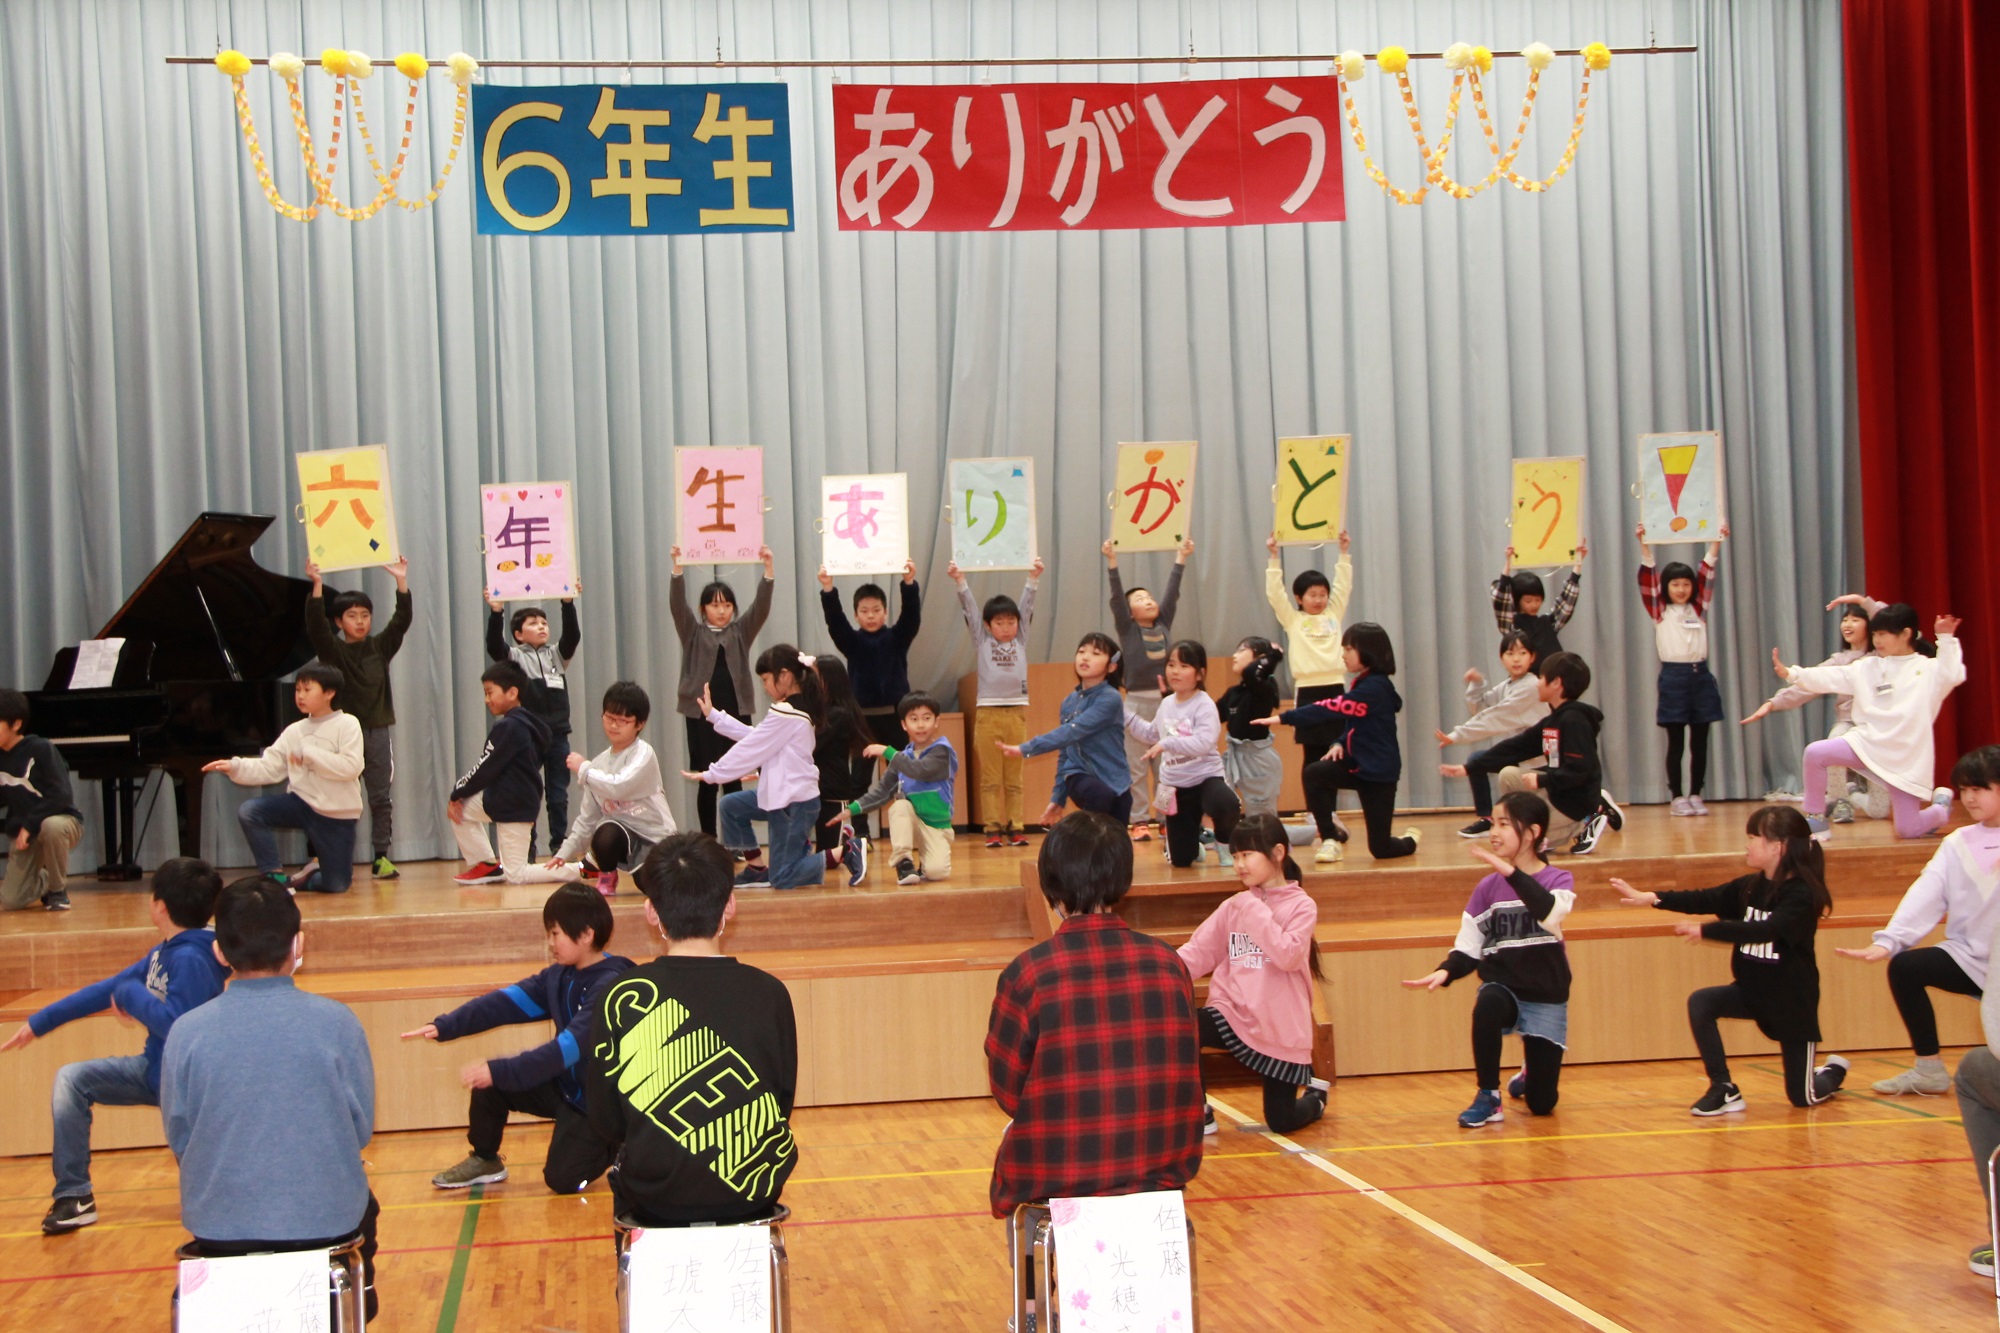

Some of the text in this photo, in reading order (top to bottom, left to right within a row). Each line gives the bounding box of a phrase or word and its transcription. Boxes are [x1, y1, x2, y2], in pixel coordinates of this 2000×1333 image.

[482, 87, 789, 231] 6年生
[839, 84, 1326, 229] ありがとう
[306, 464, 381, 530] 六
[686, 467, 746, 532] 生
[829, 483, 884, 549] あ
[964, 489, 1007, 546] り
[1124, 466, 1182, 535] が
[1289, 457, 1337, 531] と
[1531, 481, 1563, 550] う
[494, 506, 551, 570] 年
